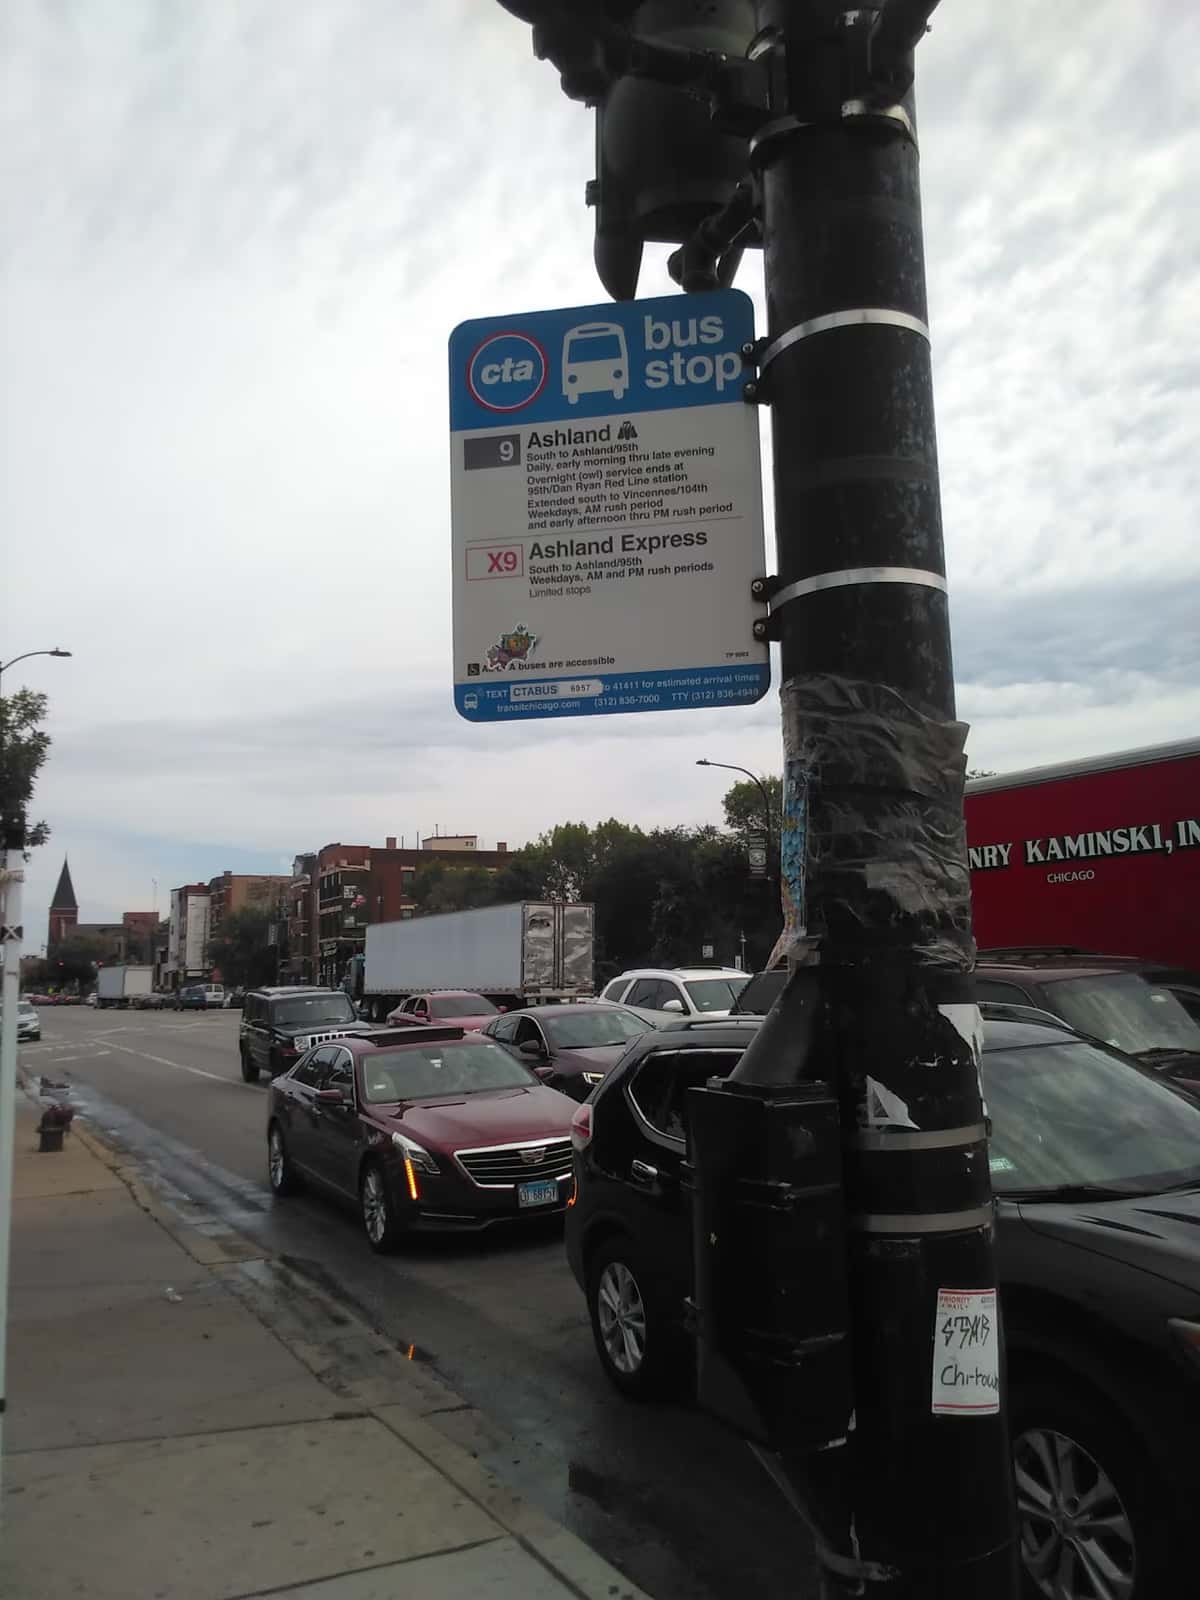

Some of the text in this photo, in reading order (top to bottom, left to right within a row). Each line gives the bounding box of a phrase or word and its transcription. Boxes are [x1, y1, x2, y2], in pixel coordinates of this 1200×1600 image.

[644, 315, 724, 351] bus
[480, 357, 534, 385] cta
[645, 351, 742, 391] stop
[527, 424, 610, 449] Ashland
[500, 440, 514, 461] 9
[527, 442, 638, 462] South to Ashland/95th
[556, 459, 580, 470] early
[584, 455, 626, 466] morning
[629, 454, 649, 463] thru
[652, 451, 671, 460] late
[674, 446, 715, 457] evening
[527, 462, 684, 485] Overnight (owl) service ends at
[527, 472, 688, 496] 95th/Dan Ryan Red Line station
[527, 484, 708, 509] Extended south to Vincennes/104th
[528, 499, 663, 519] Weekdays, AM rush period
[528, 502, 733, 530] and early afternoon thru PM rush period
[529, 531, 708, 560] Ashland Express
[488, 551, 518, 573] X9
[529, 556, 642, 575] South to Ashland/95th
[587, 571, 603, 580] AM
[606, 569, 625, 579] and
[628, 567, 644, 577] PM
[648, 565, 671, 575] rush
[674, 561, 714, 575] periods
[529, 585, 592, 598] Limited stops
[518, 661, 546, 671] buses
[549, 660, 564, 669] are
[565, 655, 615, 668] accessible
[486, 689, 509, 699] TEXT
[513, 685, 558, 698] CTABUS
[612, 680, 639, 691] 41411
[642, 680, 655, 690] for
[657, 677, 701, 689] estimated
[703, 674, 732, 685] arrival
[734, 672, 760, 683] times
[497, 700, 580, 713] transitchicago.com
[594, 696, 617, 707] (312)
[671, 691, 689, 702] TTY
[691, 690, 715, 701] (312)
[1024, 824, 1173, 864] KAMINSKI,
[1047, 869, 1095, 884] CHICAGO
